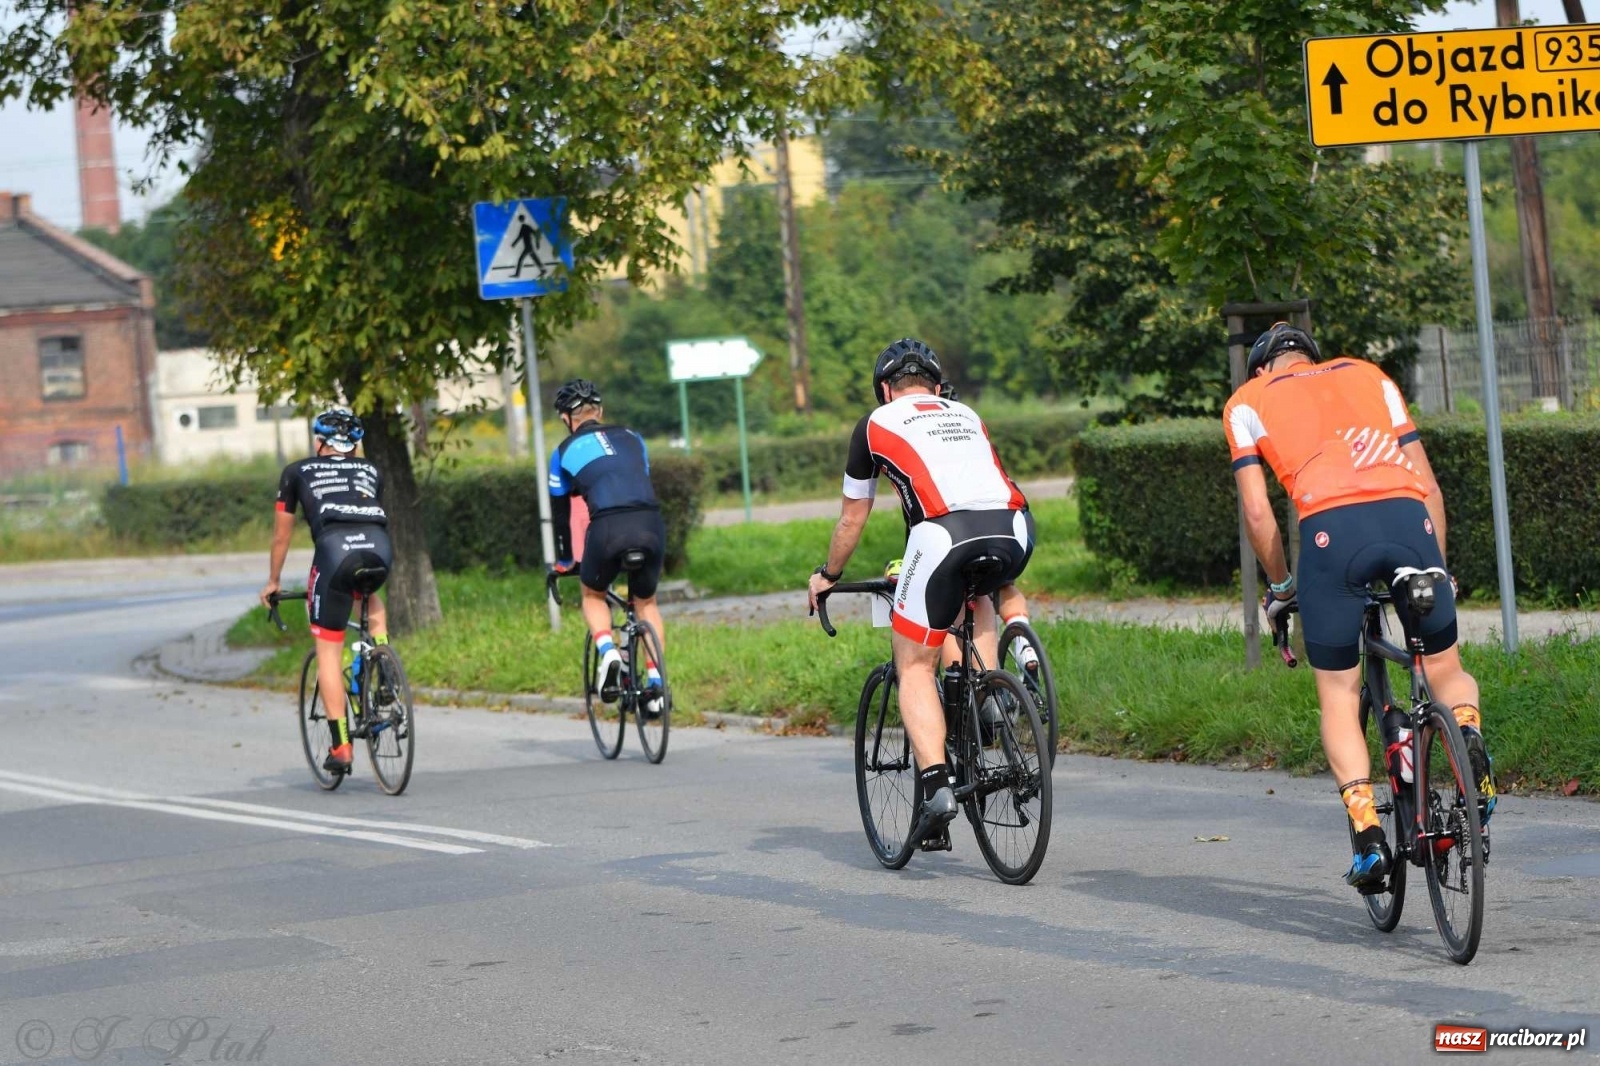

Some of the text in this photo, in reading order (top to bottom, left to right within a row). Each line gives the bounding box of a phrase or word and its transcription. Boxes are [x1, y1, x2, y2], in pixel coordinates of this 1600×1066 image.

[1366, 32, 1600, 86] Objazd 935
[1373, 87, 1428, 127] do
[900, 549, 923, 601] OMNISQUARE
